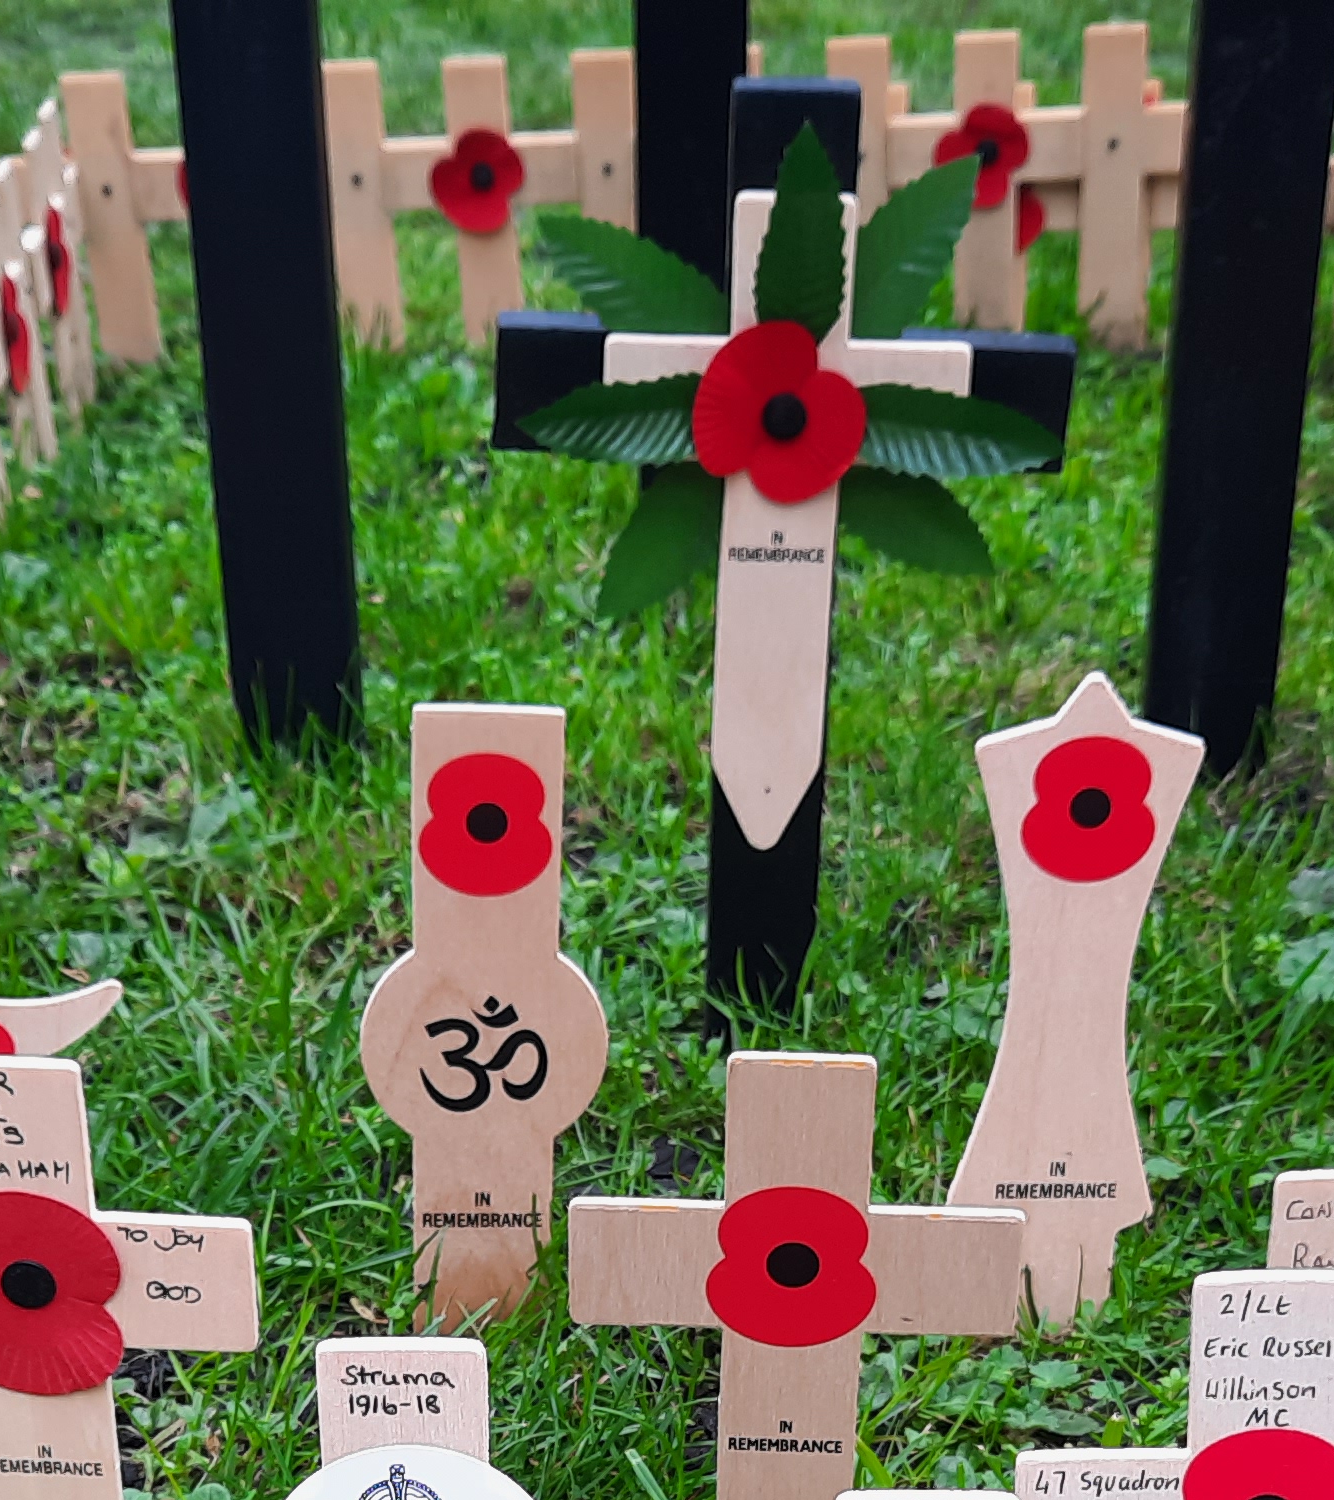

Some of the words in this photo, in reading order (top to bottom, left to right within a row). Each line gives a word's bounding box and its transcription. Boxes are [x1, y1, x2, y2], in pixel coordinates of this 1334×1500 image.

[728, 547, 825, 564] REMEMBRANCE
[1048, 1161, 1066, 1178] IN
[474, 1193, 490, 1207] IN
[994, 1182, 1117, 1201] REMEMBRANCE
[422, 1212, 543, 1230] REMEMBRANCE
[117, 1227, 148, 1243] TO
[146, 1281, 203, 1304] GOD
[1204, 1337, 1249, 1358] Eric
[340, 1364, 455, 1390] Struma
[1204, 1375, 1317, 1402] Wilkinson
[348, 1393, 442, 1417] 1916-18
[778, 1420, 793, 1434] IN
[1245, 1407, 1290, 1428] MC
[38, 1444, 52, 1459] IN
[727, 1436, 844, 1455] REMEMBRANCE
[1035, 1469, 1066, 1495] 47
[1080, 1469, 1180, 1498] Squadron
